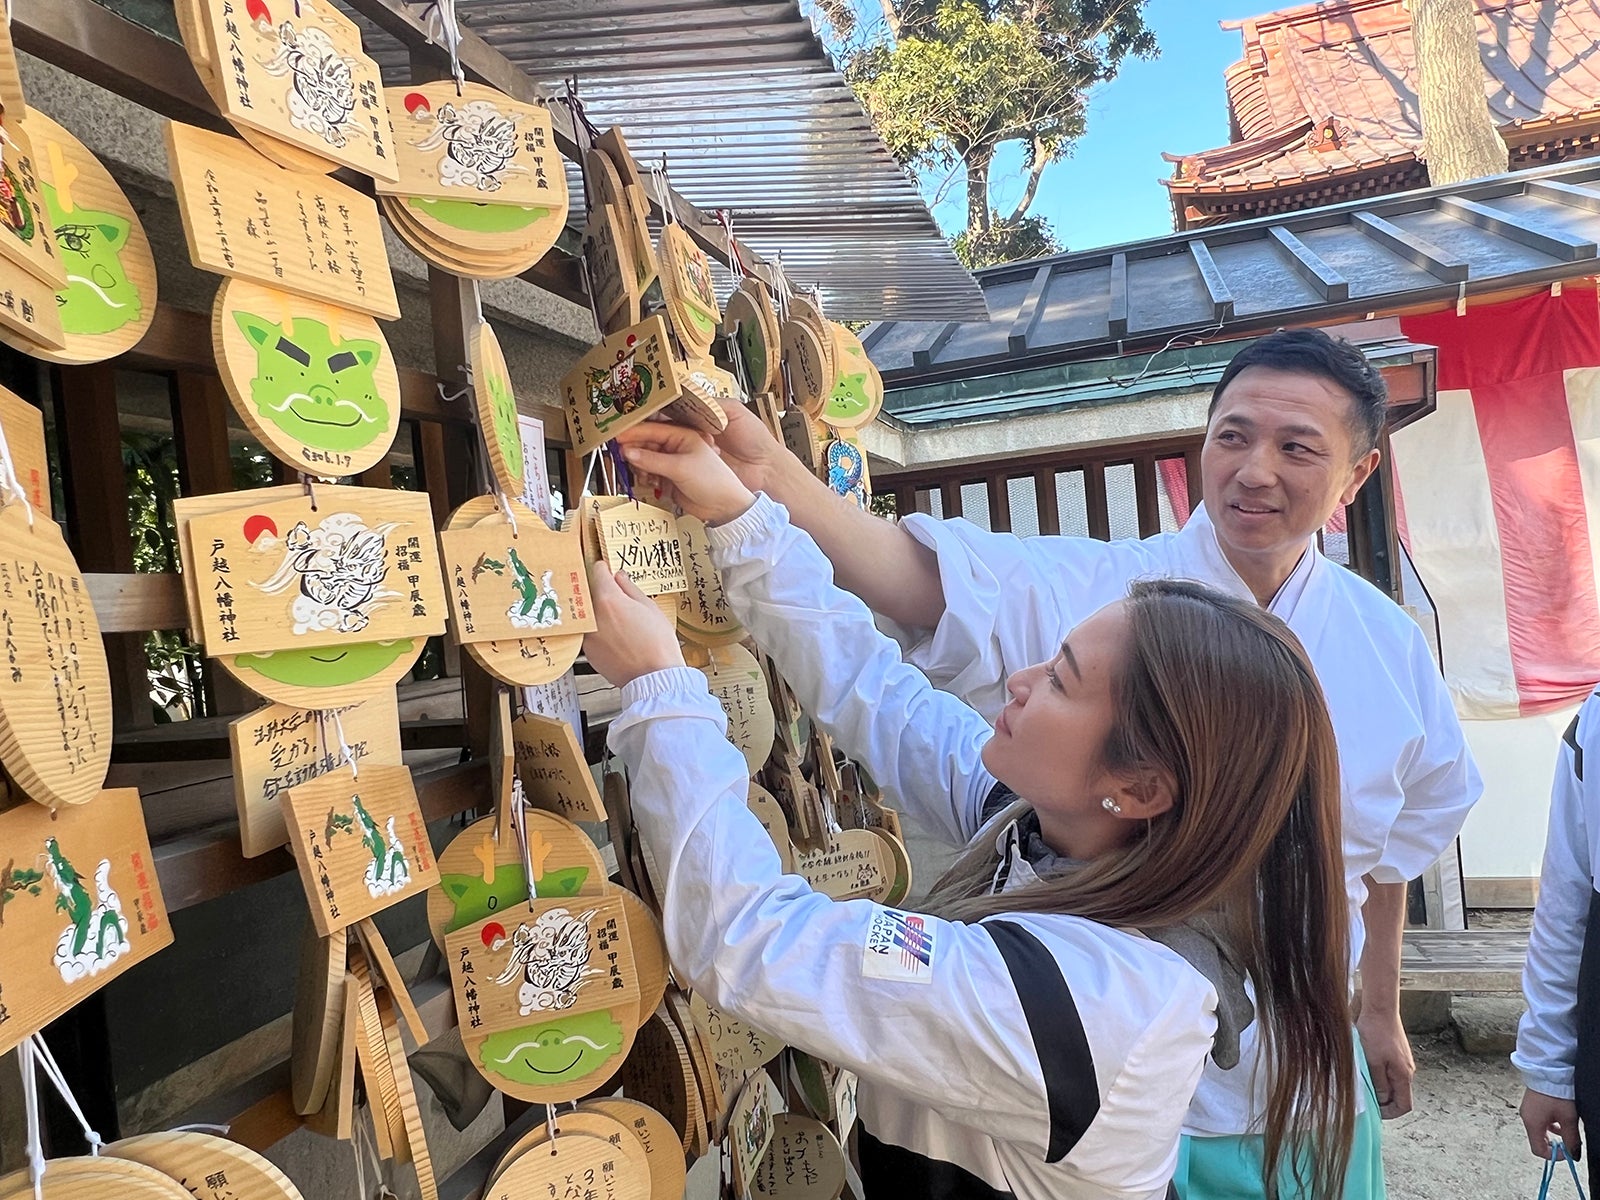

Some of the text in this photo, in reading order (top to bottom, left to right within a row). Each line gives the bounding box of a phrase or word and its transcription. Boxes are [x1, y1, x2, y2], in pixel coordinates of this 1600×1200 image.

[524, 131, 536, 153] 招福
[534, 127, 547, 149] 開運
[534, 156, 549, 190] 甲辰歳
[314, 194, 342, 275] 高校に合格
[610, 519, 670, 538] パリオリンピック
[396, 546, 410, 571] 招福
[408, 537, 423, 563] 開運
[616, 536, 682, 571] メダル獲得
[210, 538, 241, 643] 戸越八幡神社
[626, 567, 684, 583] 子ホッケーさくらJAPAN
[407, 575, 427, 617] 甲辰歳
[455, 564, 476, 634] 戸越八幡神社
[309, 829, 341, 919] 戸越八幡神社
[597, 928, 610, 951] 招福
[606, 918, 619, 942] 開運
[869, 913, 884, 953] HOCKEY
[882, 916, 894, 955] JAPAN
[460, 947, 483, 1029] 戸越八幡神社
[607, 952, 624, 990] 甲辰歳
